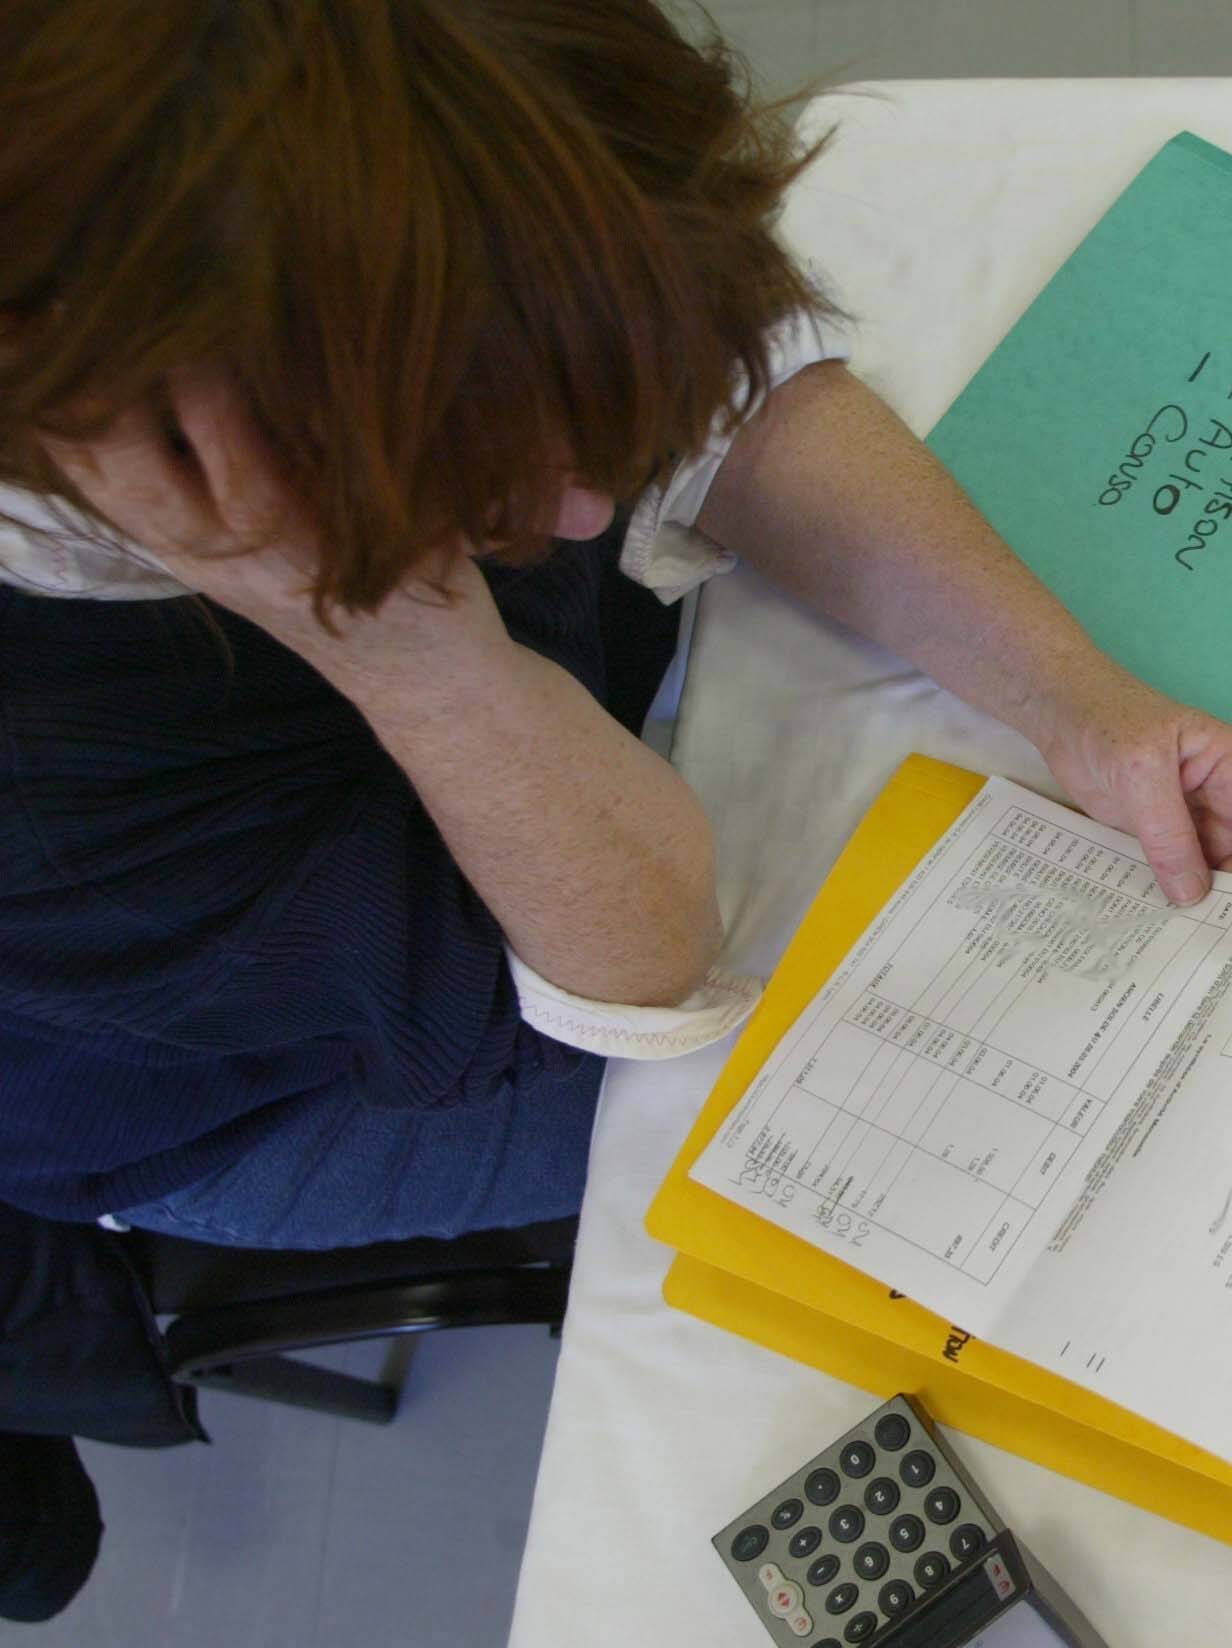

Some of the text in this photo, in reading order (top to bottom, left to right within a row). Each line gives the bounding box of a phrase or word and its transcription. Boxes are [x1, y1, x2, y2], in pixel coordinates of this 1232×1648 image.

[1217, 901, 1232, 921] DATE
[1069, 1097, 1093, 1129] VALEUR
[987, 1220, 1010, 1252] CREDIT
